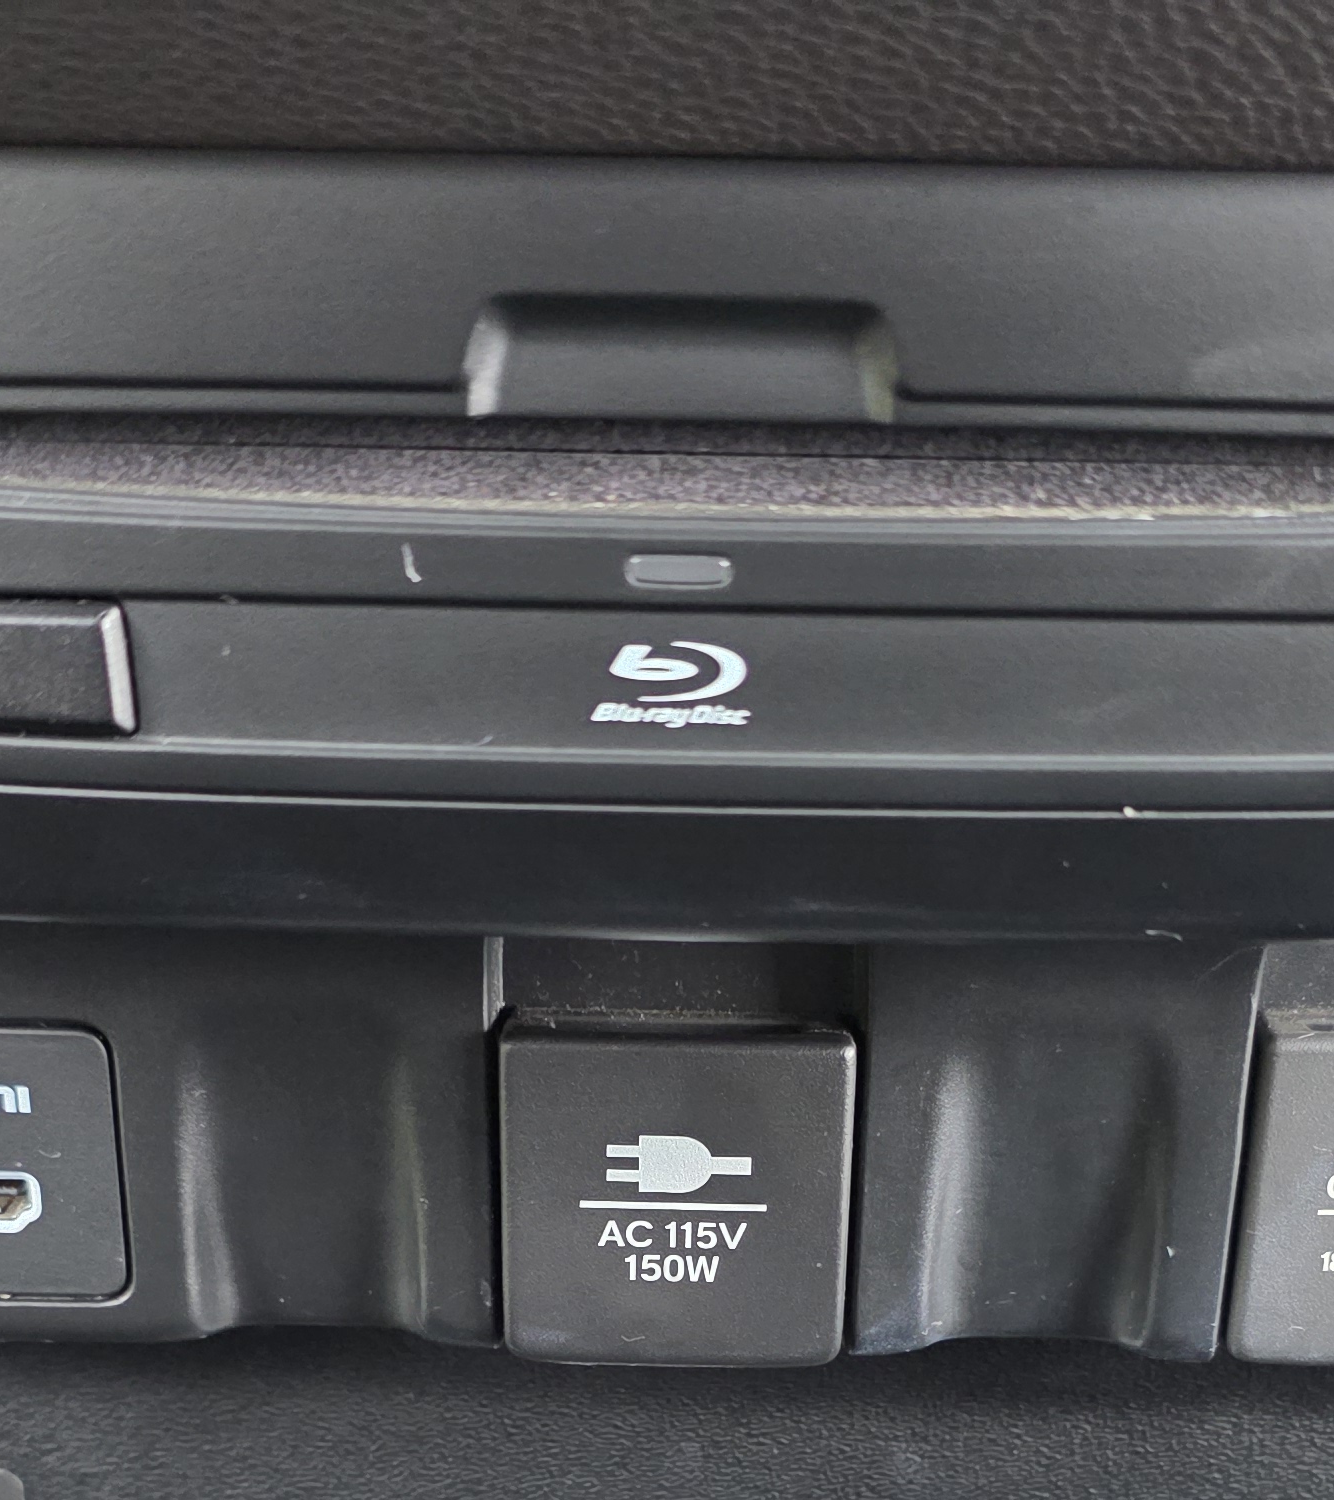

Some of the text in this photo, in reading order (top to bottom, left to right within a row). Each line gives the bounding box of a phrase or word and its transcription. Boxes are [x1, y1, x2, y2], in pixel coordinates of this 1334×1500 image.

[597, 1219, 748, 1250] AC 115V
[624, 1254, 720, 1283] 150W
